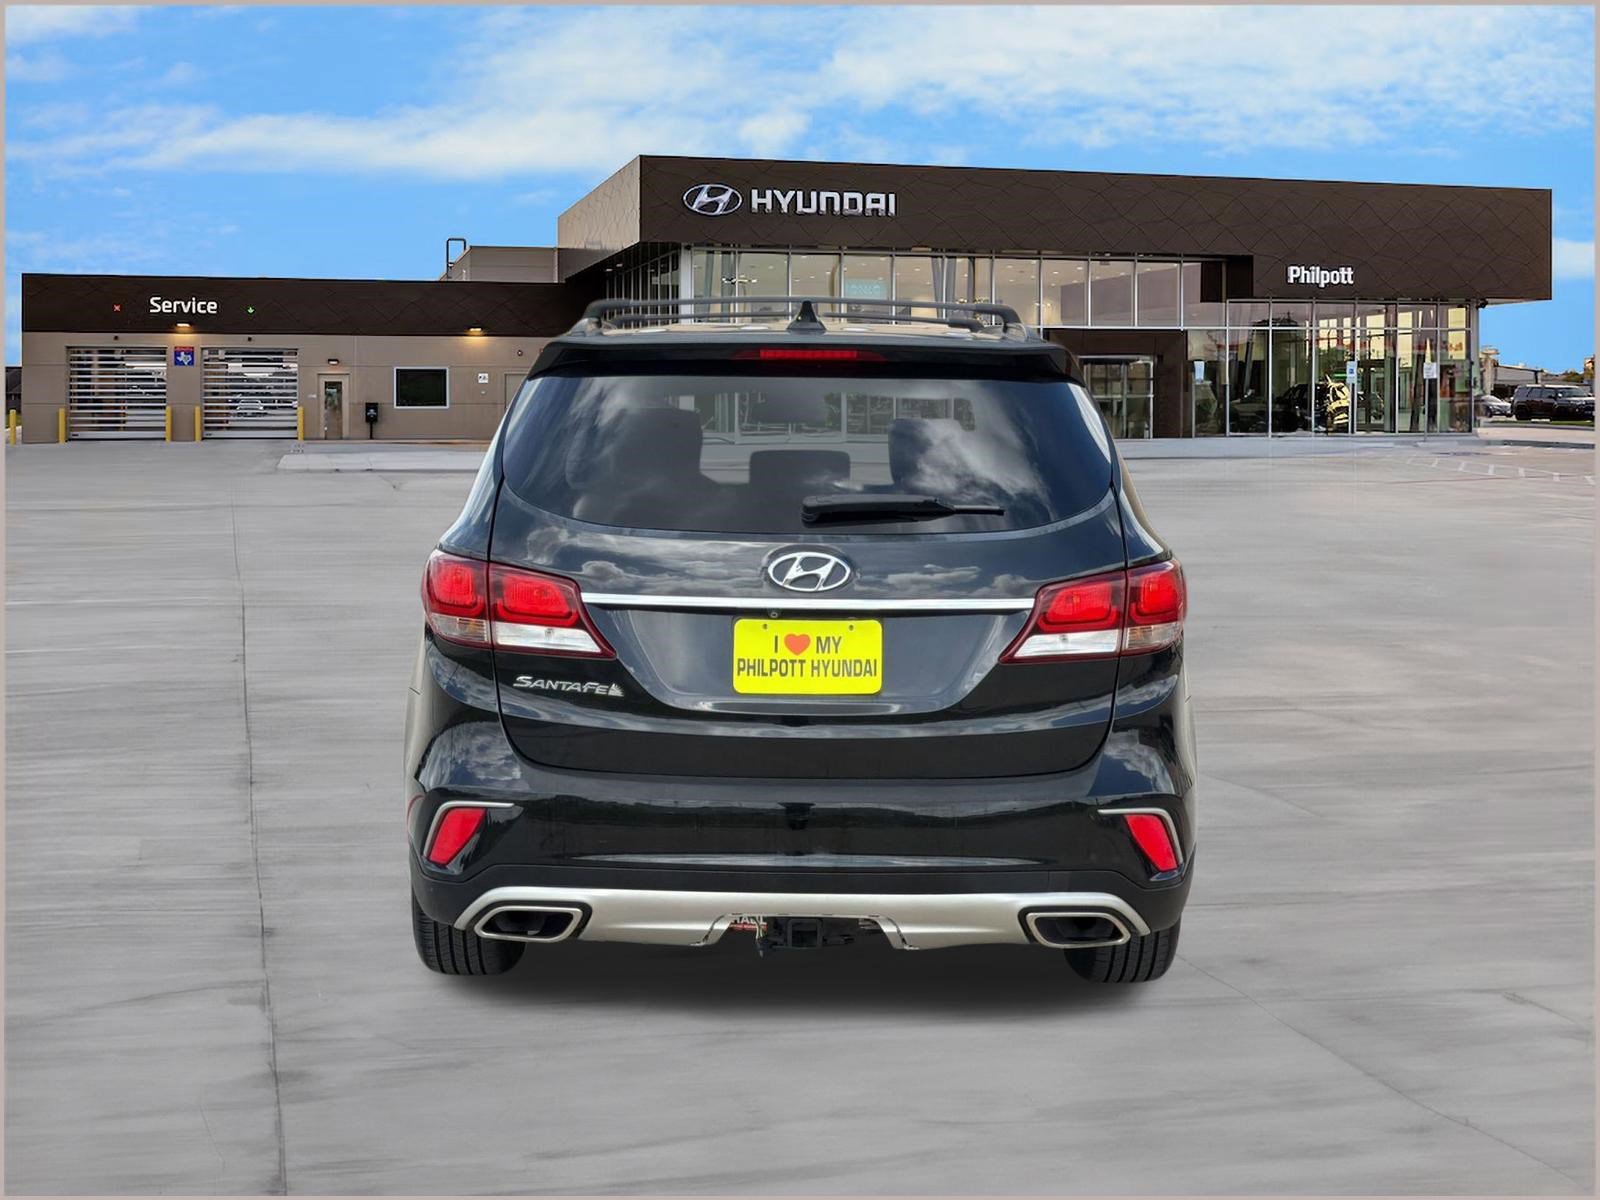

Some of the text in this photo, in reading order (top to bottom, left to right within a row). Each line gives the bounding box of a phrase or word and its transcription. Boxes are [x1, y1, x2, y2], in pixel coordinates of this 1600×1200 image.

[751, 188, 896, 217] HYUNDAI
[1287, 265, 1355, 288] Philpott
[149, 296, 218, 315] Service
[774, 635, 842, 654] I MY
[736, 658, 878, 677] PHILPOTT HYUNDAI
